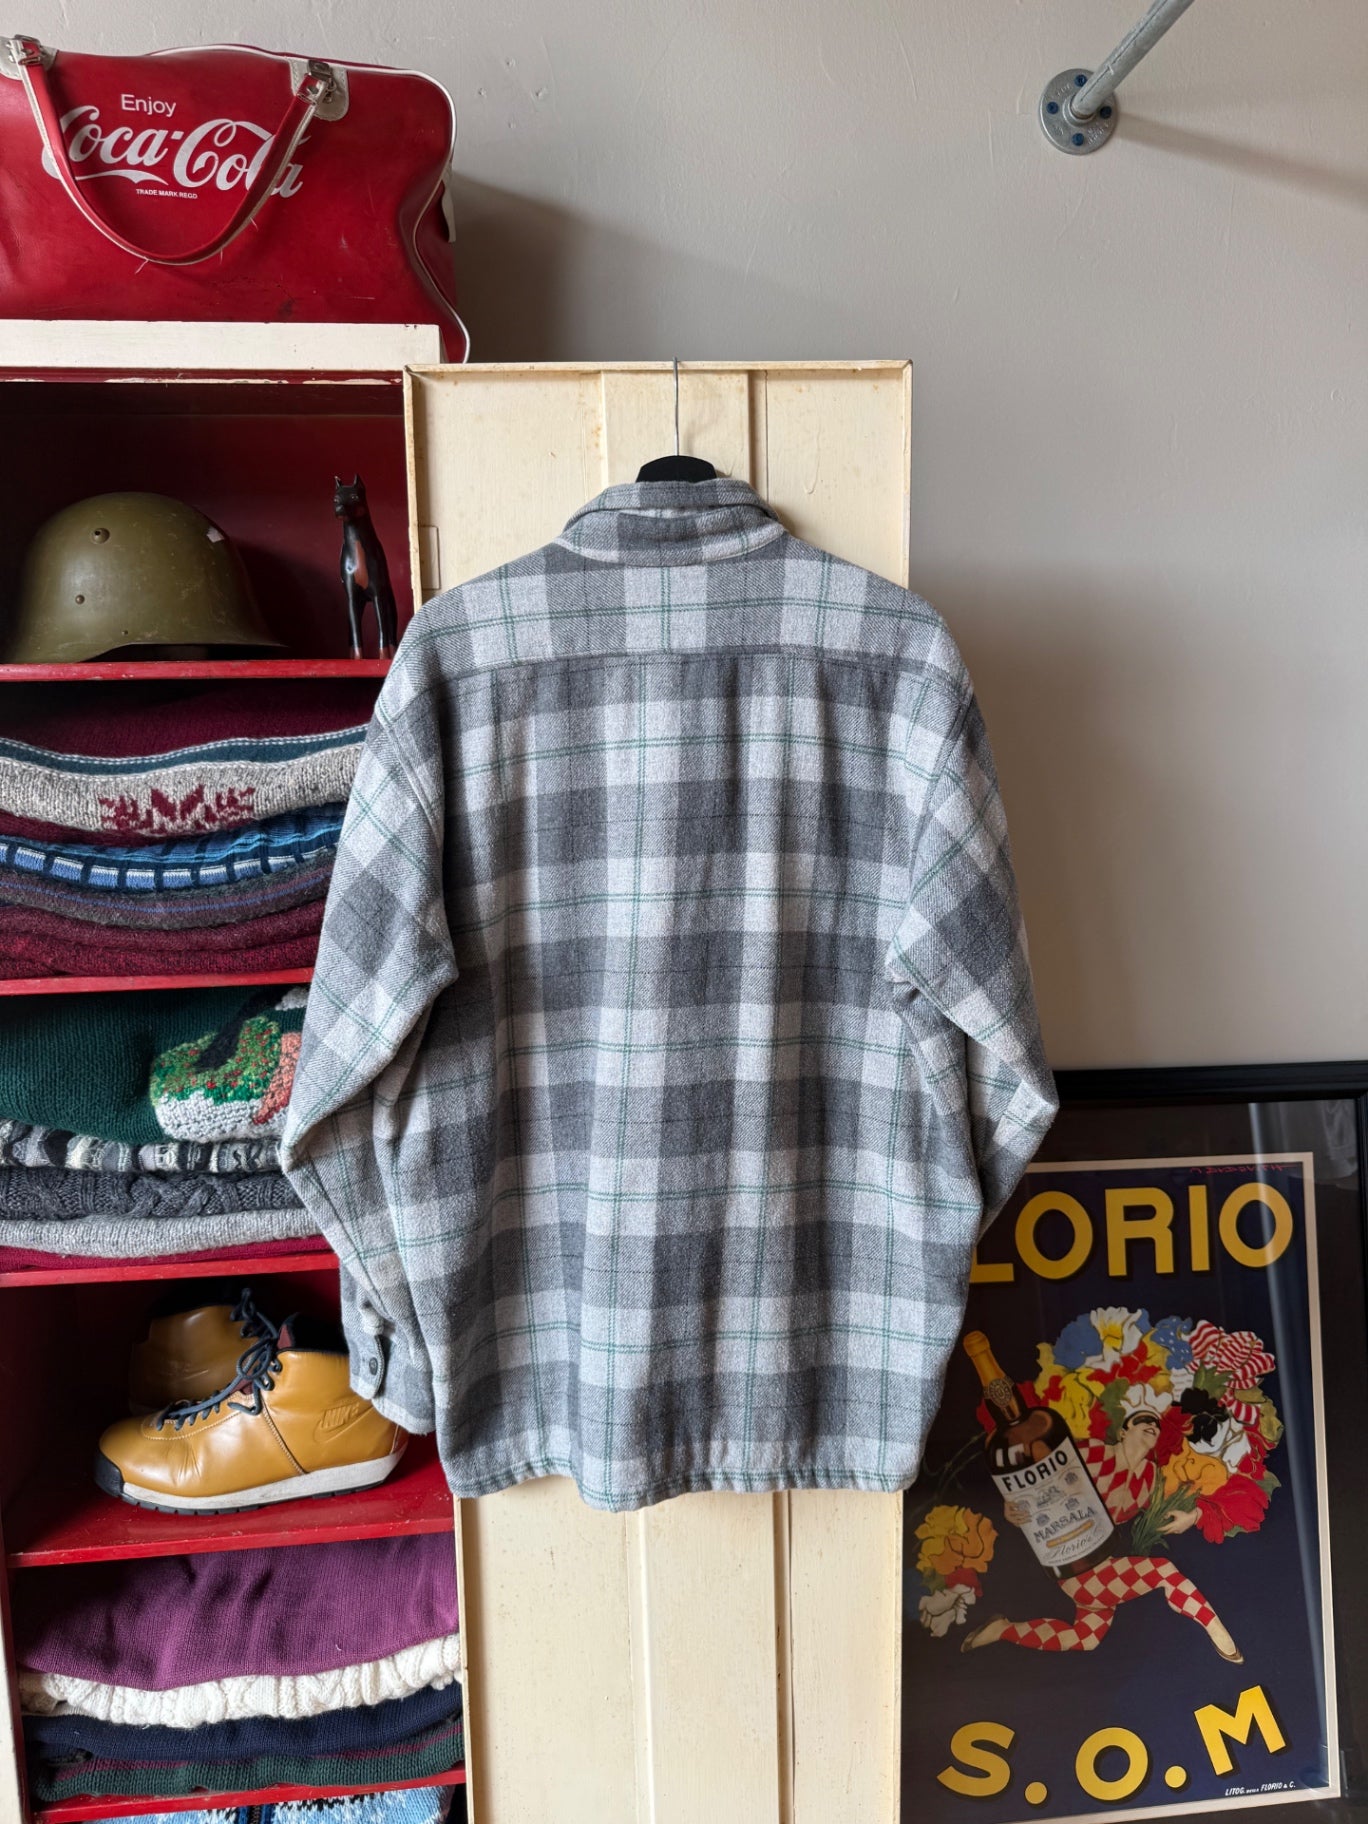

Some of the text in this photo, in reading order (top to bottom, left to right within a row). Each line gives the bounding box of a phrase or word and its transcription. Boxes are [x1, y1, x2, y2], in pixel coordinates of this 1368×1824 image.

[121, 94, 176, 117] Enjoy
[136, 188, 158, 196] TRADE
[1002, 1450, 1068, 1492] FLORIO
[1033, 1506, 1096, 1543] MARSALA
[1260, 1783, 1282, 1791] FLORIO
